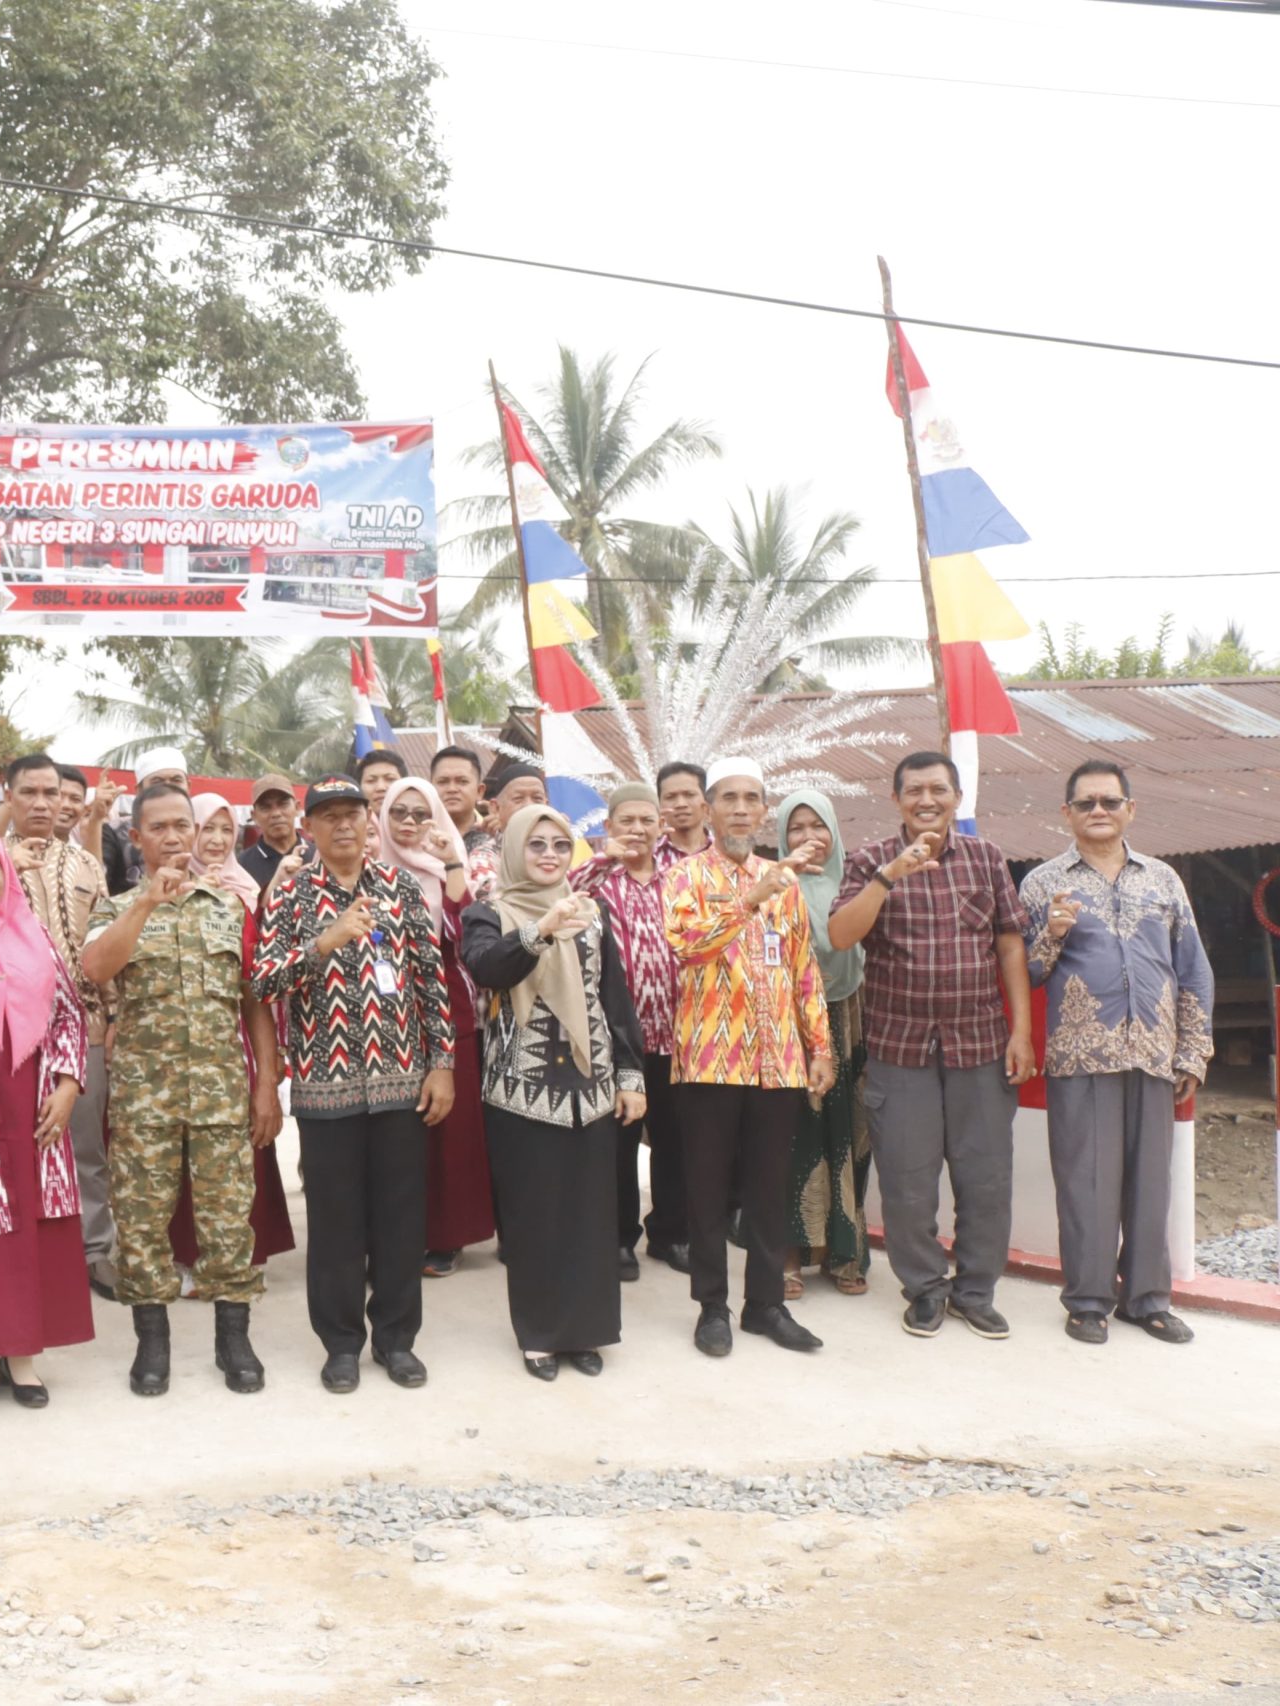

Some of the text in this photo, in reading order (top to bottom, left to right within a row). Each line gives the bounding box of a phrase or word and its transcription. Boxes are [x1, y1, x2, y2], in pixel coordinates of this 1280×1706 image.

[10, 437, 236, 470] PERESMIAN
[81, 482, 204, 508] PERINTIS
[210, 482, 320, 509] GARUDA
[347, 505, 424, 528] TNI AD
[10, 519, 96, 545] NEGERI
[99, 520, 117, 545] 3
[121, 520, 207, 545] SUNGAI
[210, 520, 298, 546] PINYUH
[82, 589, 102, 605] 22
[106, 590, 180, 605] OKTOBER
[142, 923, 166, 934] DIMIN
[205, 921, 240, 934] TNI AD
